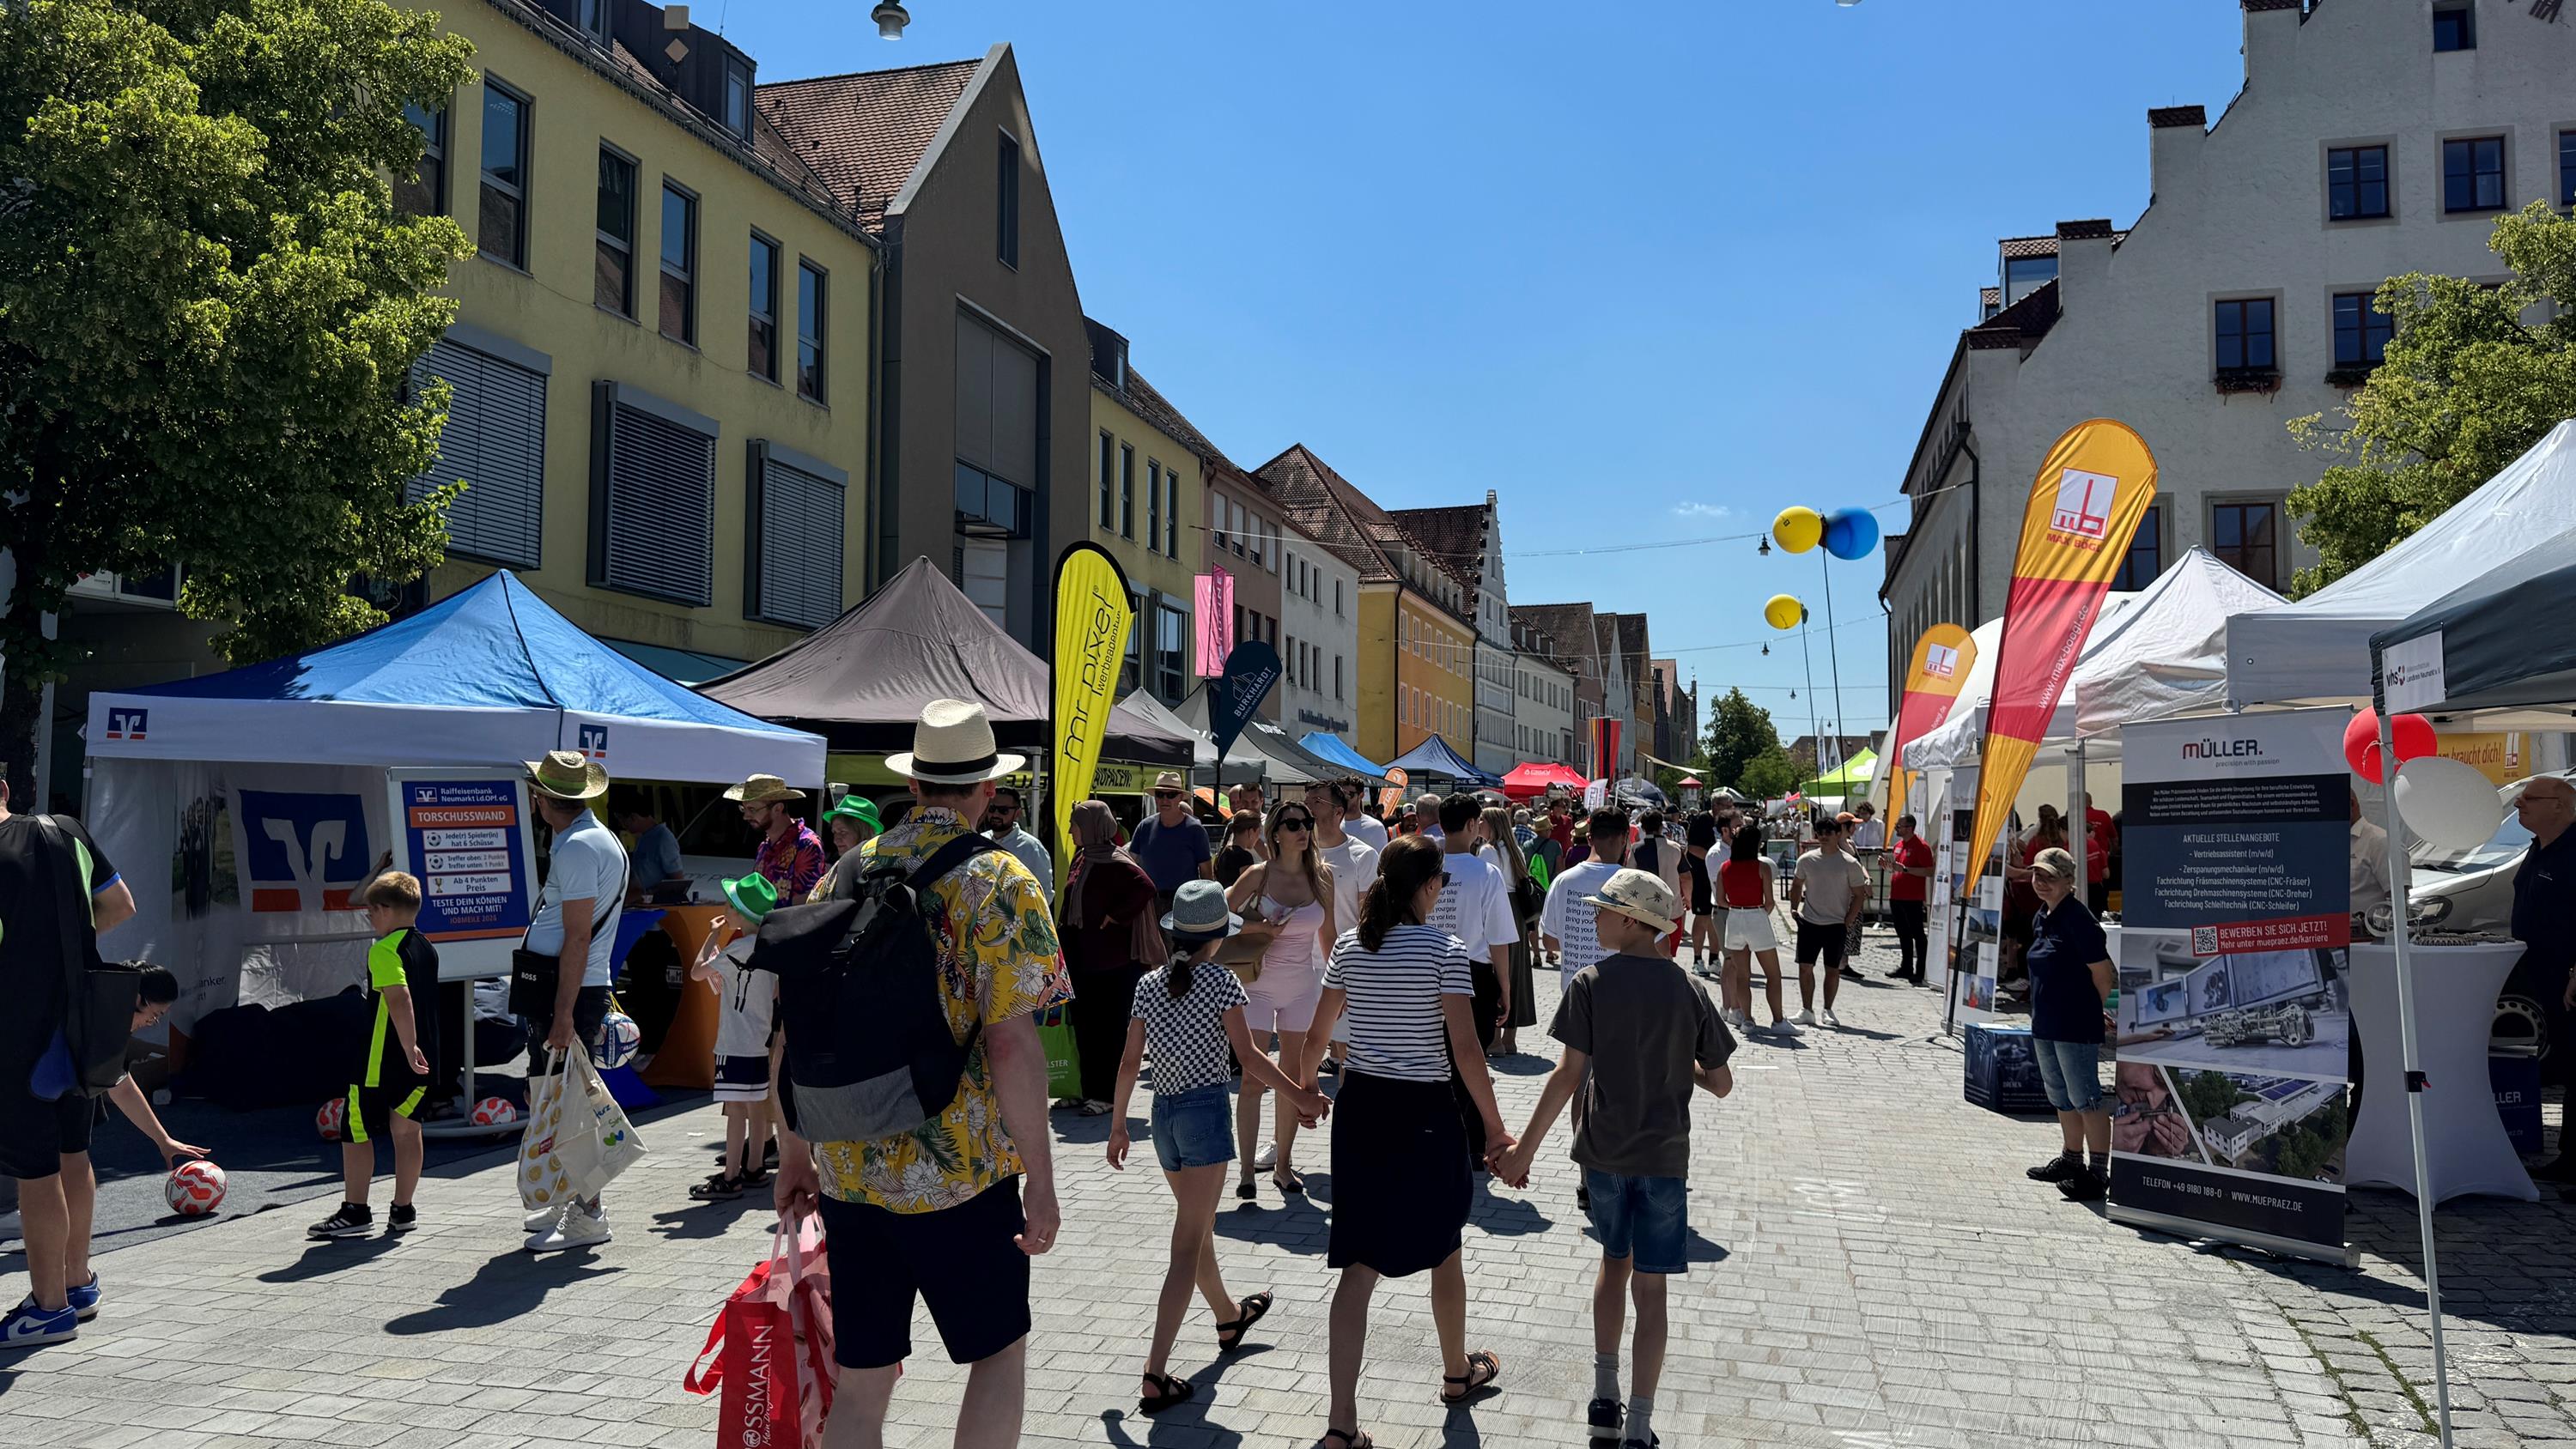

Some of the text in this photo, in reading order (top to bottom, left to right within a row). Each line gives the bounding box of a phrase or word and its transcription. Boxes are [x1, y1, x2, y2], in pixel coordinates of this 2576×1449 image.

[2046, 533, 2070, 546] MAX
[2386, 669, 2398, 687] vhs
[1233, 666, 1273, 718] BURKHARDT
[1064, 700, 1088, 763] mr
[2451, 742, 2501, 765] braucht dich!
[2215, 759, 2243, 767] precision
[2257, 758, 2280, 767] passion
[417, 811, 506, 822] TORSCHUSSWAND
[468, 831, 499, 840] Spieler(in)
[2183, 833, 2280, 843] AKTUELLE STELLENANGEBOTE
[2194, 848, 2274, 858] Vertriebsassistent (m/w/d)
[2183, 864, 2284, 875] Zerspanungsmechaniker (m/w/d)
[2157, 876, 2311, 887] Fachrichtung Fräsmaschinensysteme (CNC-Fräser)
[2154, 888, 2312, 899] Fachrichtung Drehmaschinensysteme (CNC-Dreher)
[432, 896, 507, 907] TESTE DEIN KÖNNEN
[2165, 900, 2300, 911] Fachrichtung Schleiftechnik (CNC-Schleifer)
[1565, 916, 1580, 925] Bring
[1565, 925, 1579, 933] Bring
[2220, 920, 2328, 939] BEWERBEN SIE SICH JETZT!
[1564, 933, 1579, 942] Bring
[2221, 941, 2235, 949] Mehr
[2257, 934, 2329, 948] muepraez.de/karriere
[1564, 942, 1579, 950] Bring
[1564, 950, 1578, 959] Bring
[1564, 959, 1578, 967] Bring
[521, 972, 537, 981] BOSS
[2142, 1176, 2303, 1212] TELEFON +49 9180 188-0 WWW.MUEPRAEZ.DE
